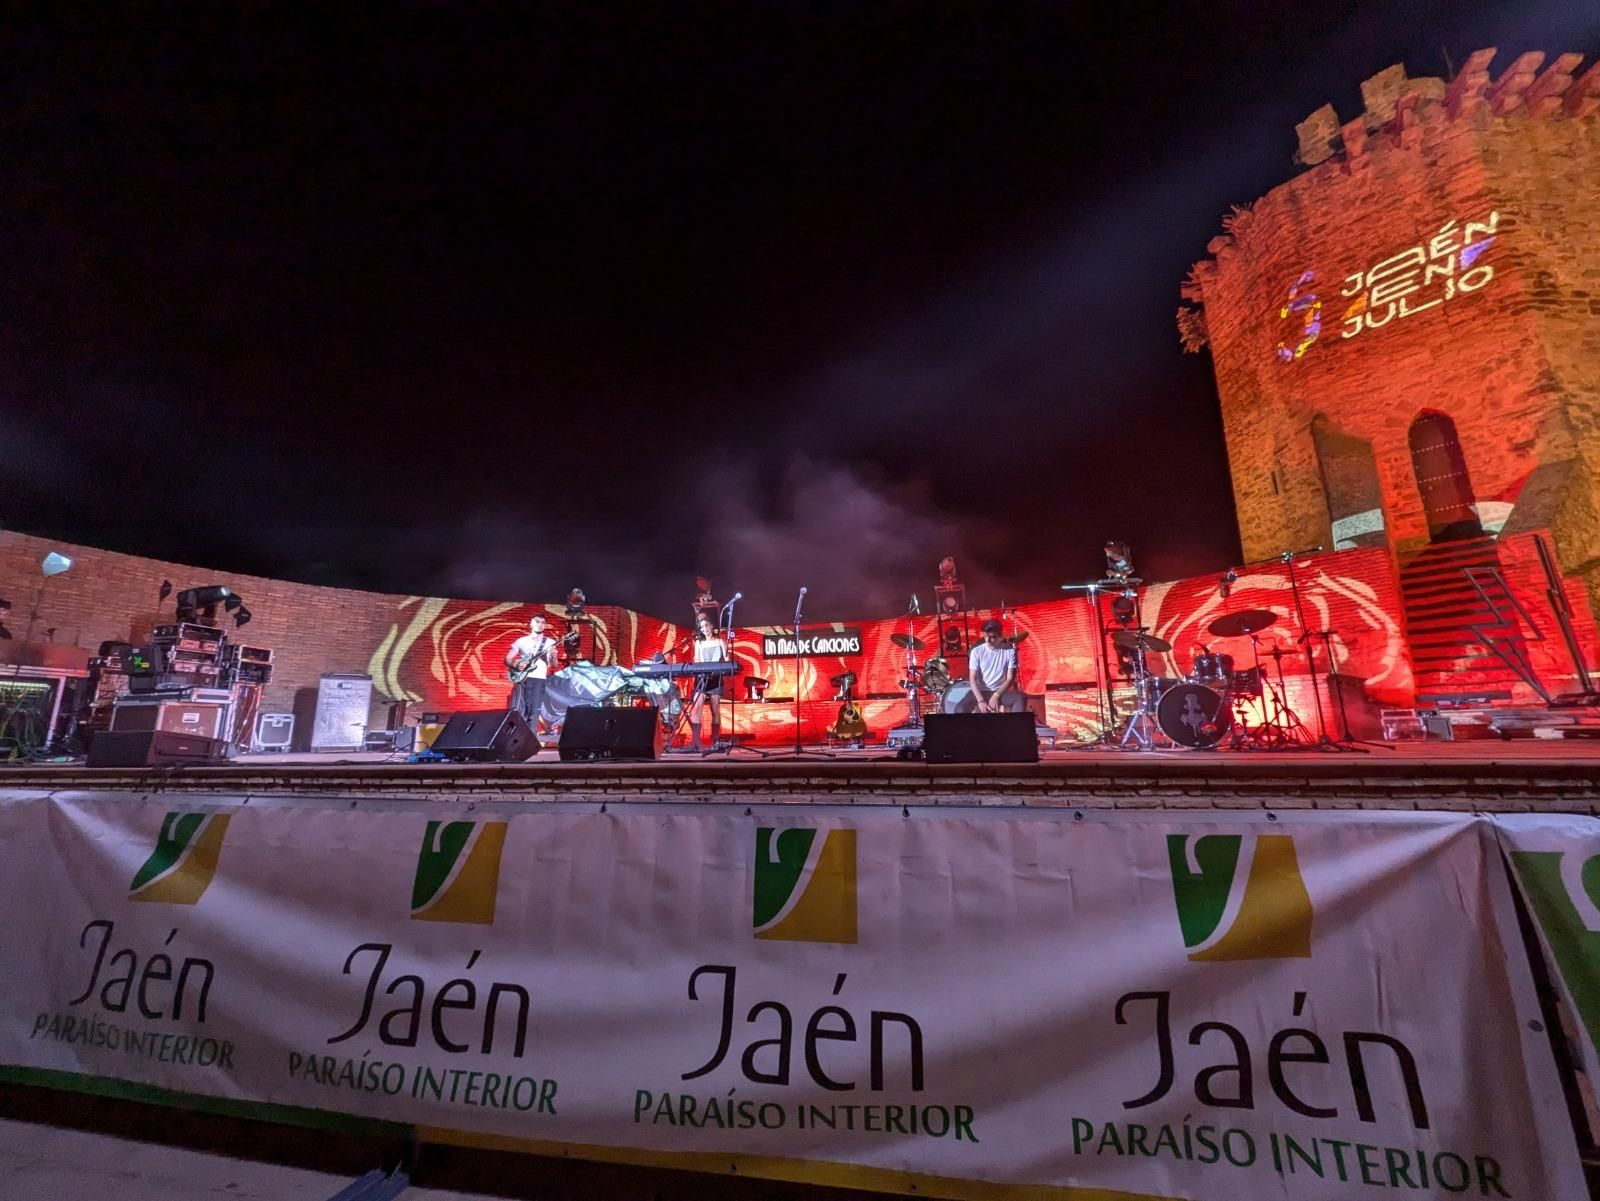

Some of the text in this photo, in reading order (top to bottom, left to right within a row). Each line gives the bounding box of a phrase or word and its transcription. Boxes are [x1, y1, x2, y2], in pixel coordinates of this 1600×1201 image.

[1342, 265, 1494, 339] JULIO
[70, 920, 215, 1023] Jaén
[328, 943, 530, 1058] Jaén
[29, 1012, 236, 1070] PARAÍSO INTERIOR
[681, 965, 925, 1091] Jaén
[1114, 991, 1431, 1130] Jaén
[288, 1050, 559, 1116] PARAÍSO INTERIOR
[634, 1088, 980, 1144] PARAÍSO INTERIOR
[1071, 1114, 1512, 1199] PARAÍSO INTERIOR
